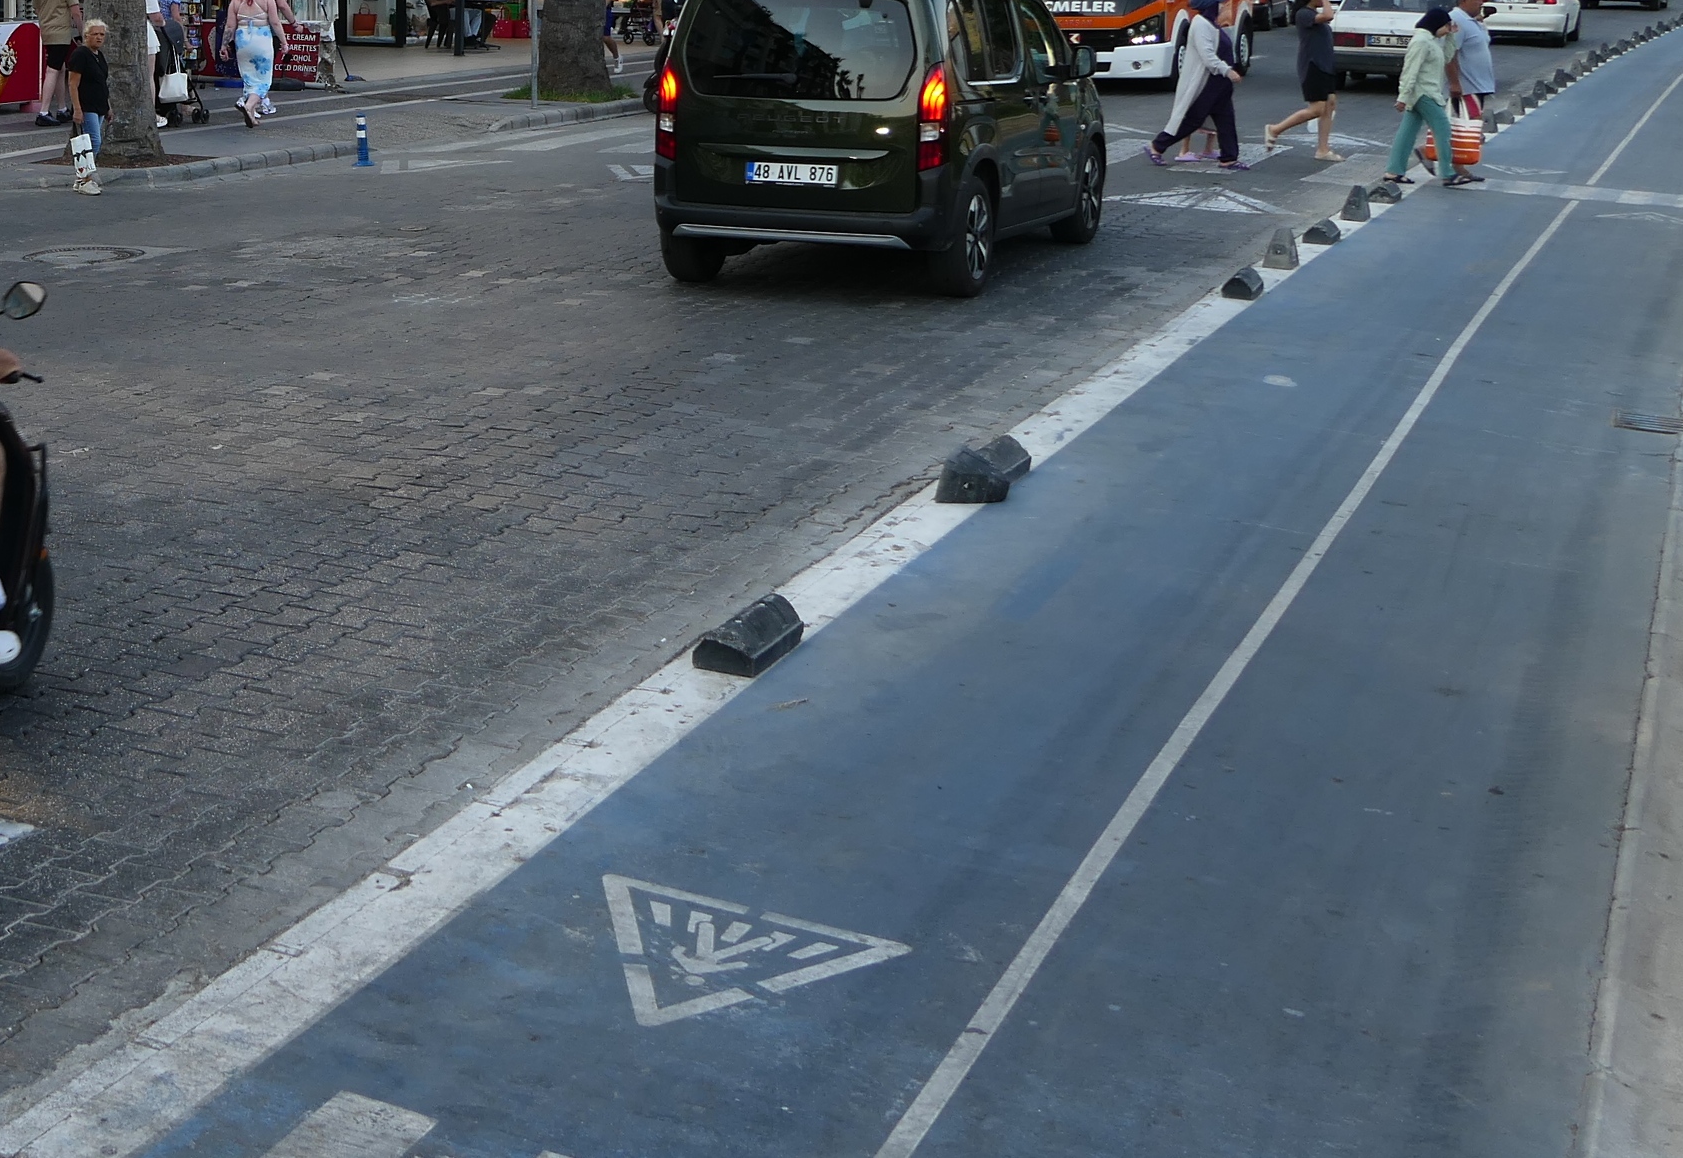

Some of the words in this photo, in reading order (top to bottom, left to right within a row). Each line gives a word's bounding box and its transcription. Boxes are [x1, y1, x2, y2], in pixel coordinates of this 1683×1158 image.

[1045, 0, 1116, 13] CMELER
[292, 33, 316, 42] CREAM
[754, 164, 770, 179] 48
[777, 165, 801, 181] AVL
[809, 166, 834, 182] 876
